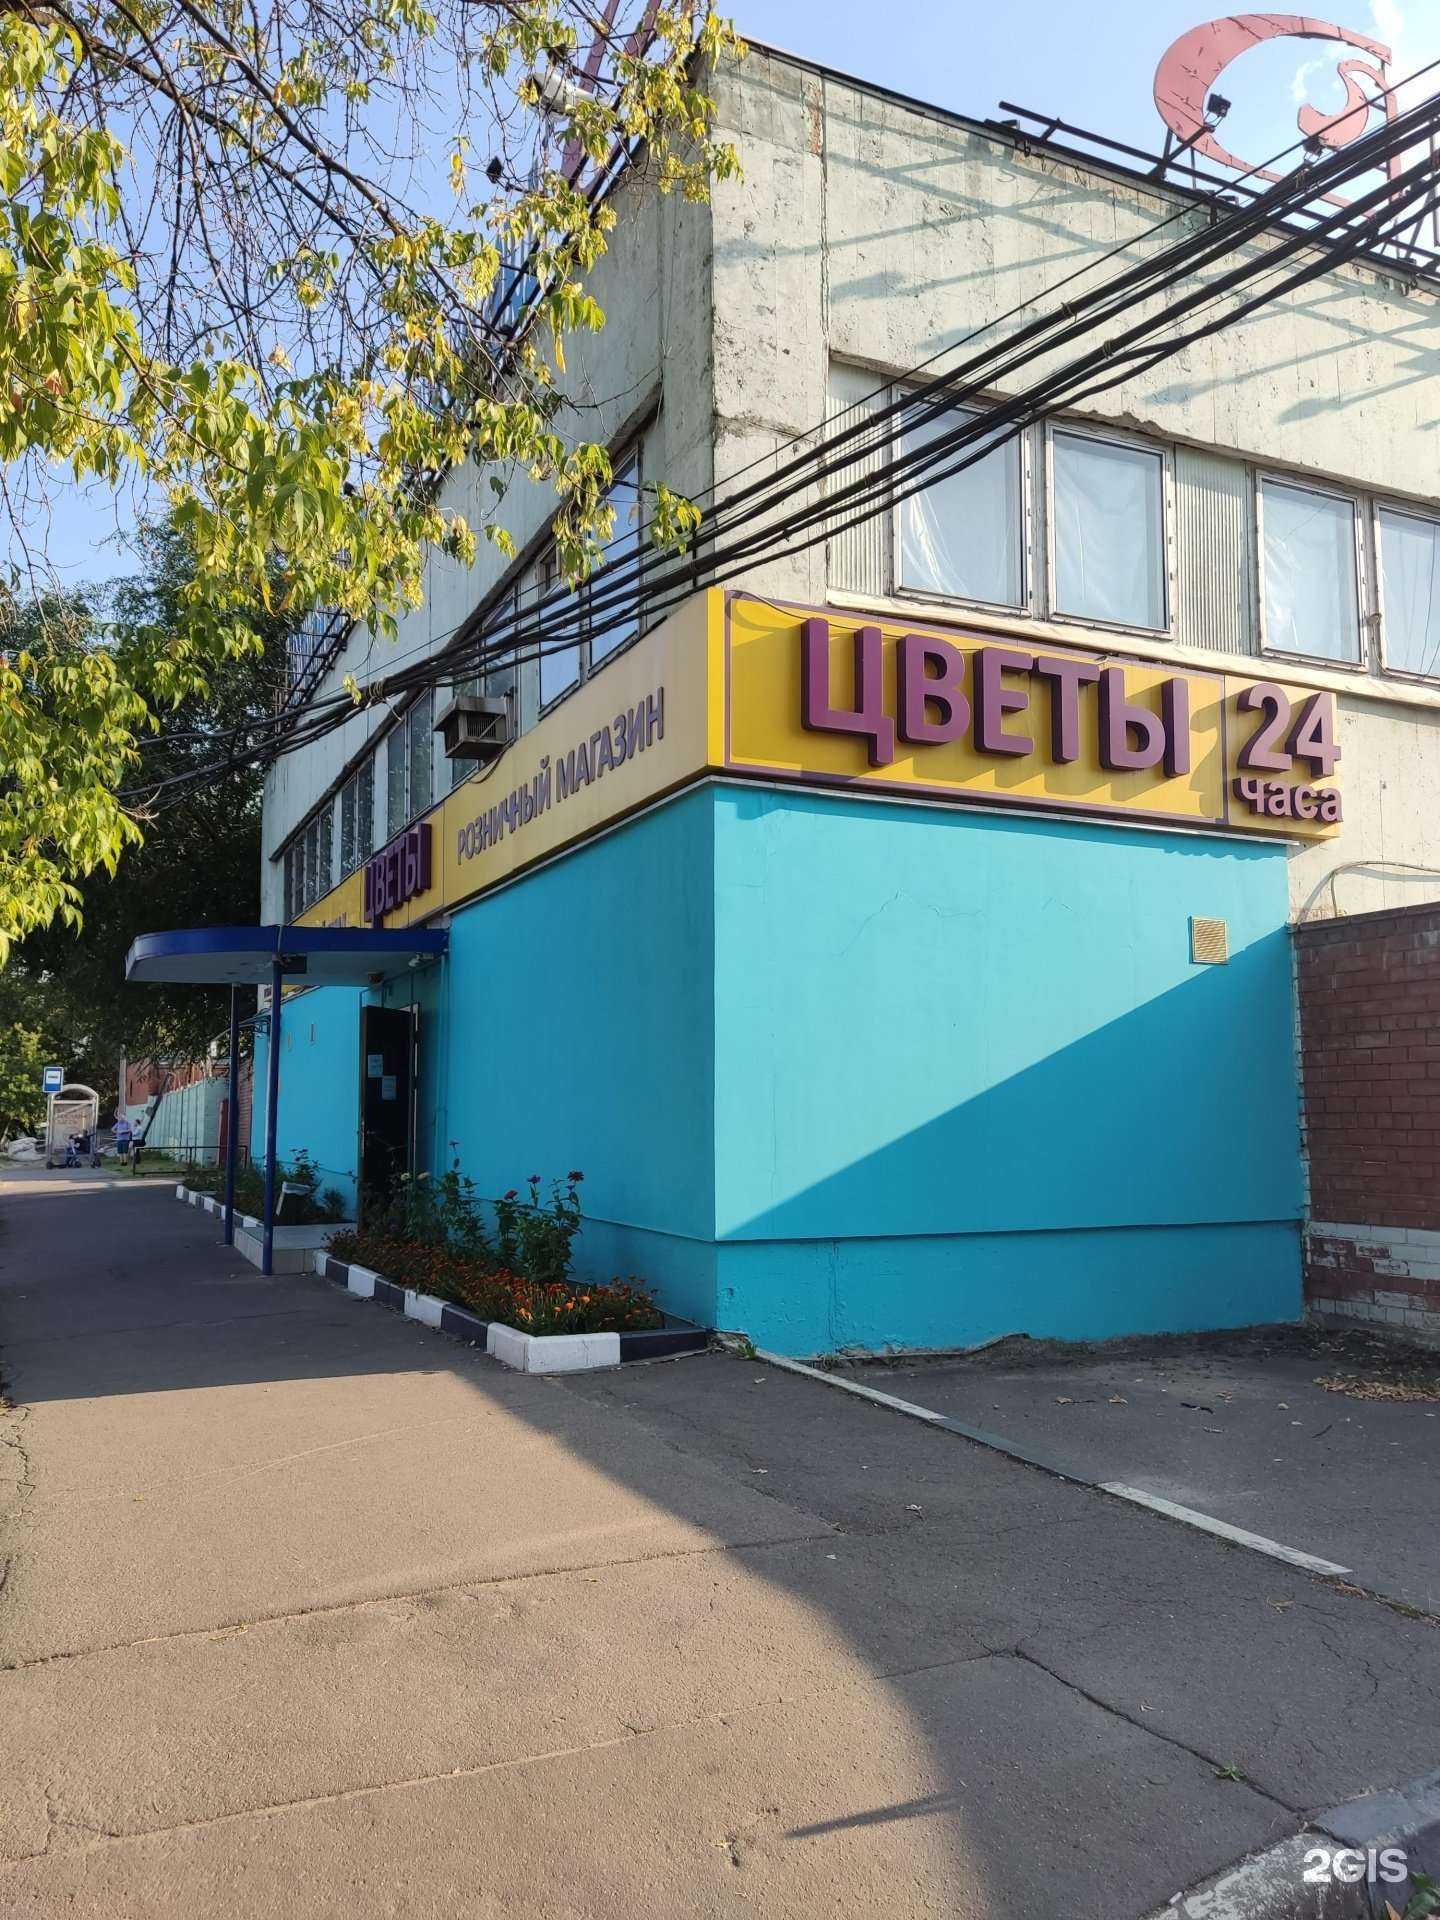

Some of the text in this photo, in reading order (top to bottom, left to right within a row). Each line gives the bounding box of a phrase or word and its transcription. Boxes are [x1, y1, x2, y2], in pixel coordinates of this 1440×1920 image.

[801, 617, 1190, 777] ЦВЕТЫ
[1237, 682, 1341, 778] 24
[457, 686, 664, 865] РОЗНИЧНЫЙ МАГАЗИН
[1232, 776, 1343, 823] часа
[364, 823, 432, 929] ЦВЕТЫ
